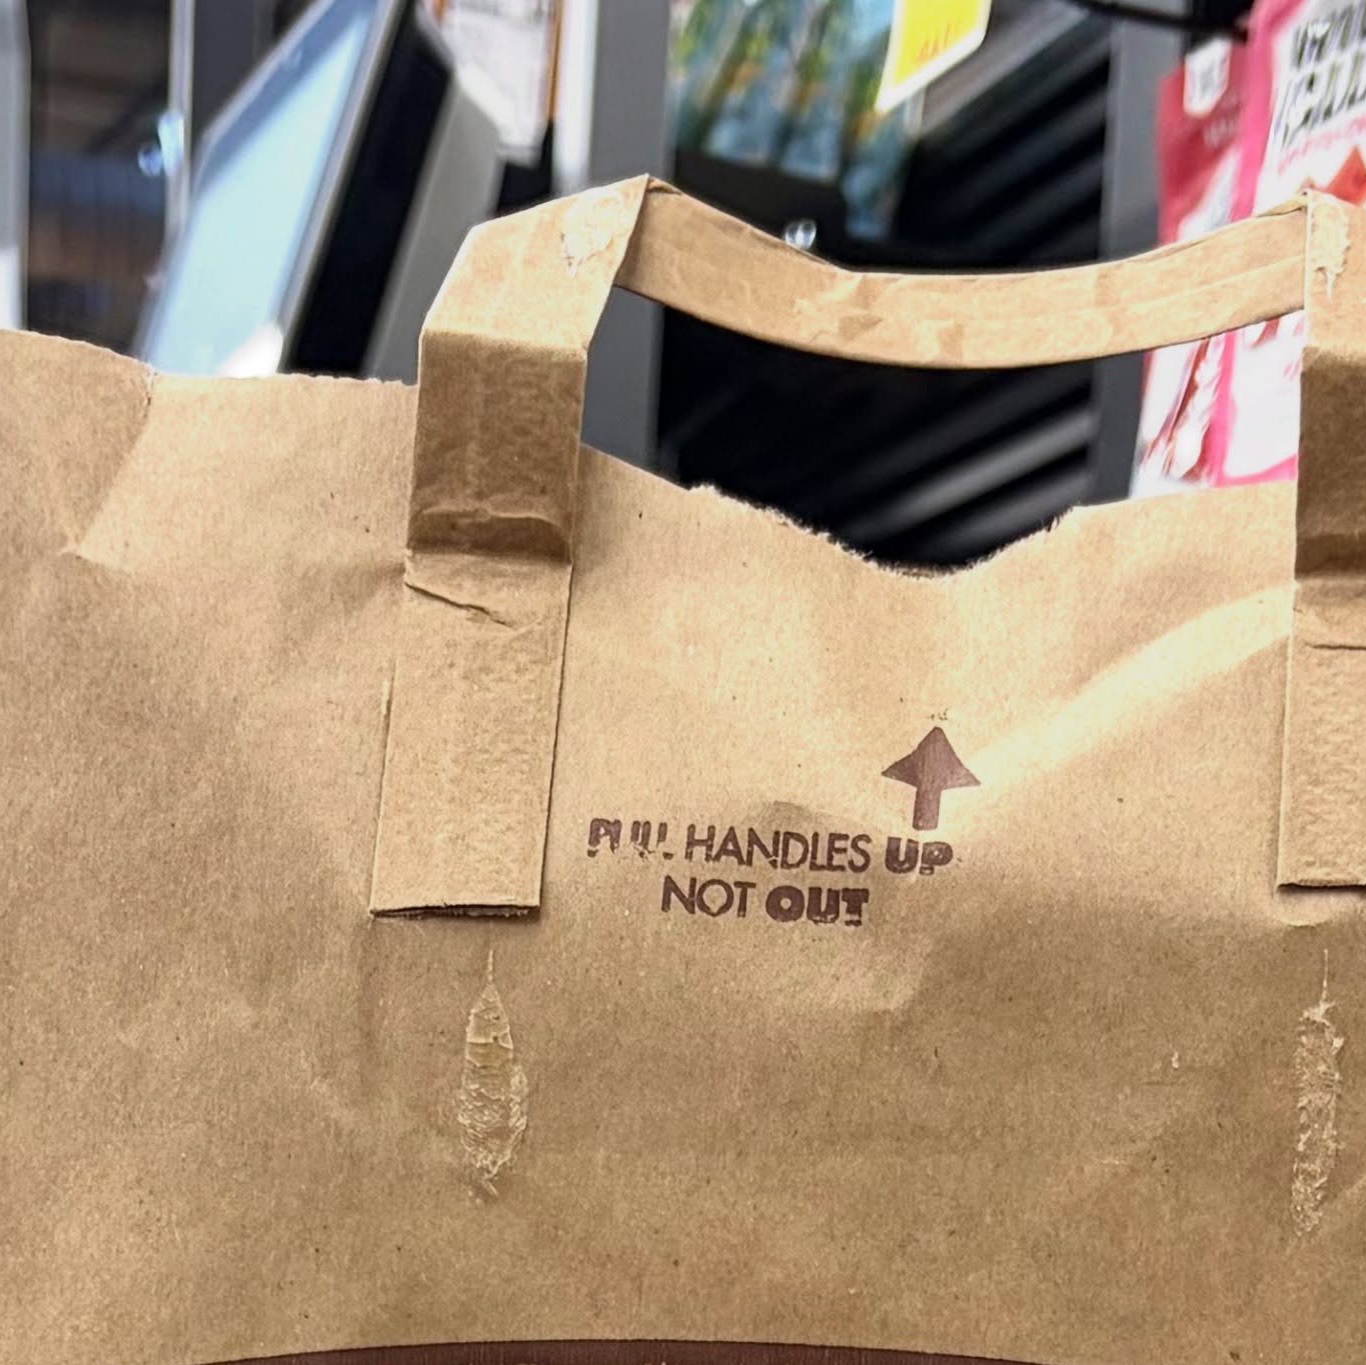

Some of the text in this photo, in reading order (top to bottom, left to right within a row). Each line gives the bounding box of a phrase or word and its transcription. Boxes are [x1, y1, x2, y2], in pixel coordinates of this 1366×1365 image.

[685, 823, 872, 873] HANDLES
[884, 837, 954, 875] UP
[661, 875, 870, 927] NOT OUT
